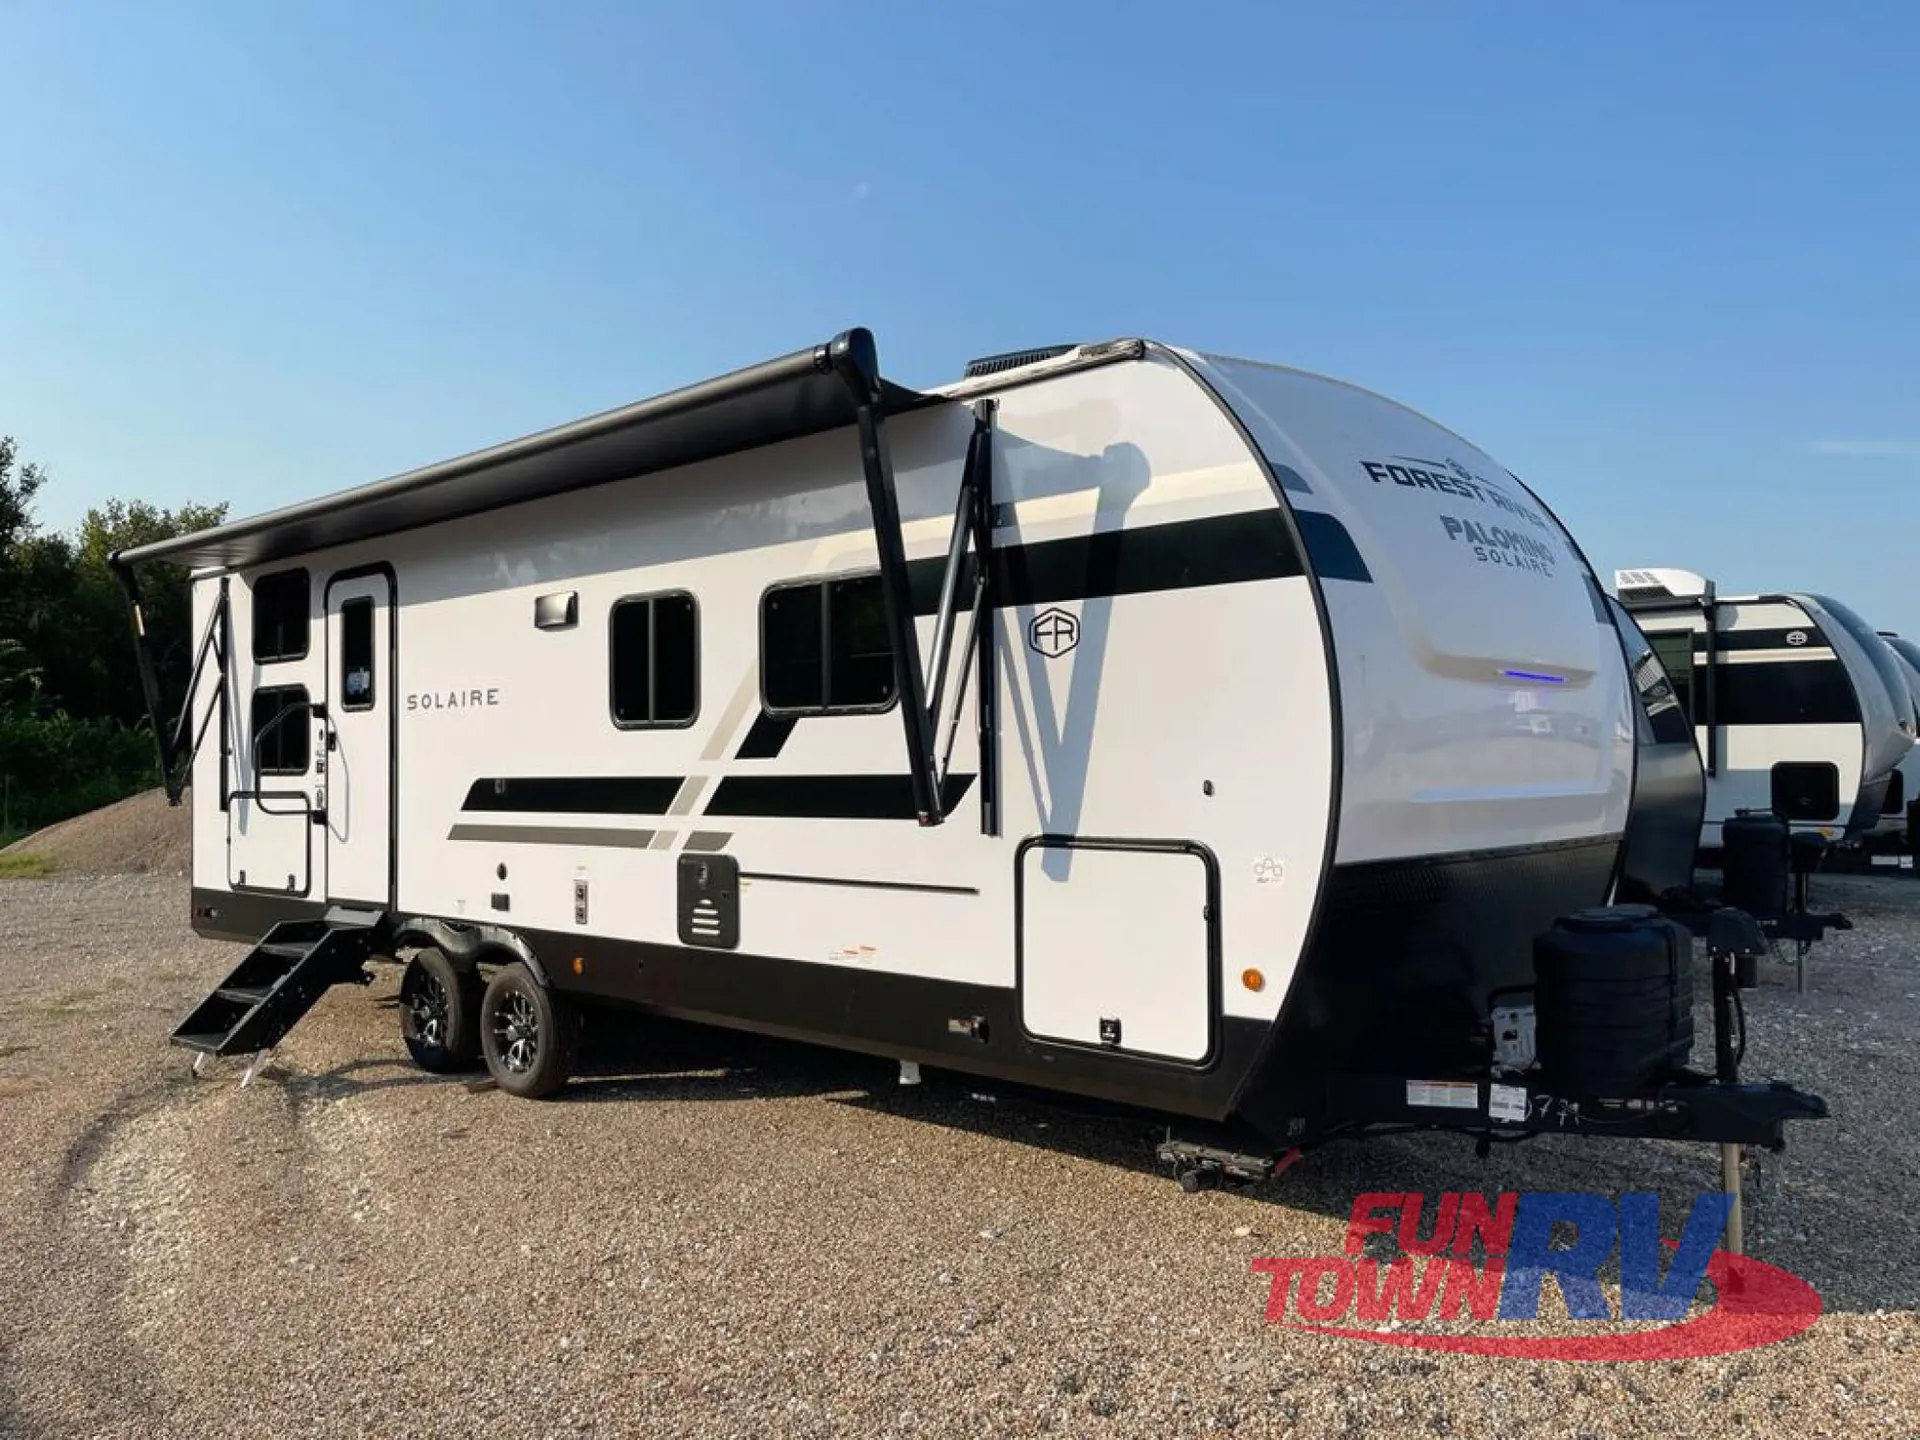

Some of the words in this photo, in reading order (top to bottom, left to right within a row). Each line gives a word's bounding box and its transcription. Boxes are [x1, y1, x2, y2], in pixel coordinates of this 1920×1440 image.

[1360, 460, 1486, 502] FOREST
[1440, 514, 1556, 566] PALOMINO
[1473, 546, 1553, 578] SOLAIRE
[406, 687, 500, 711] SOLAIRE
